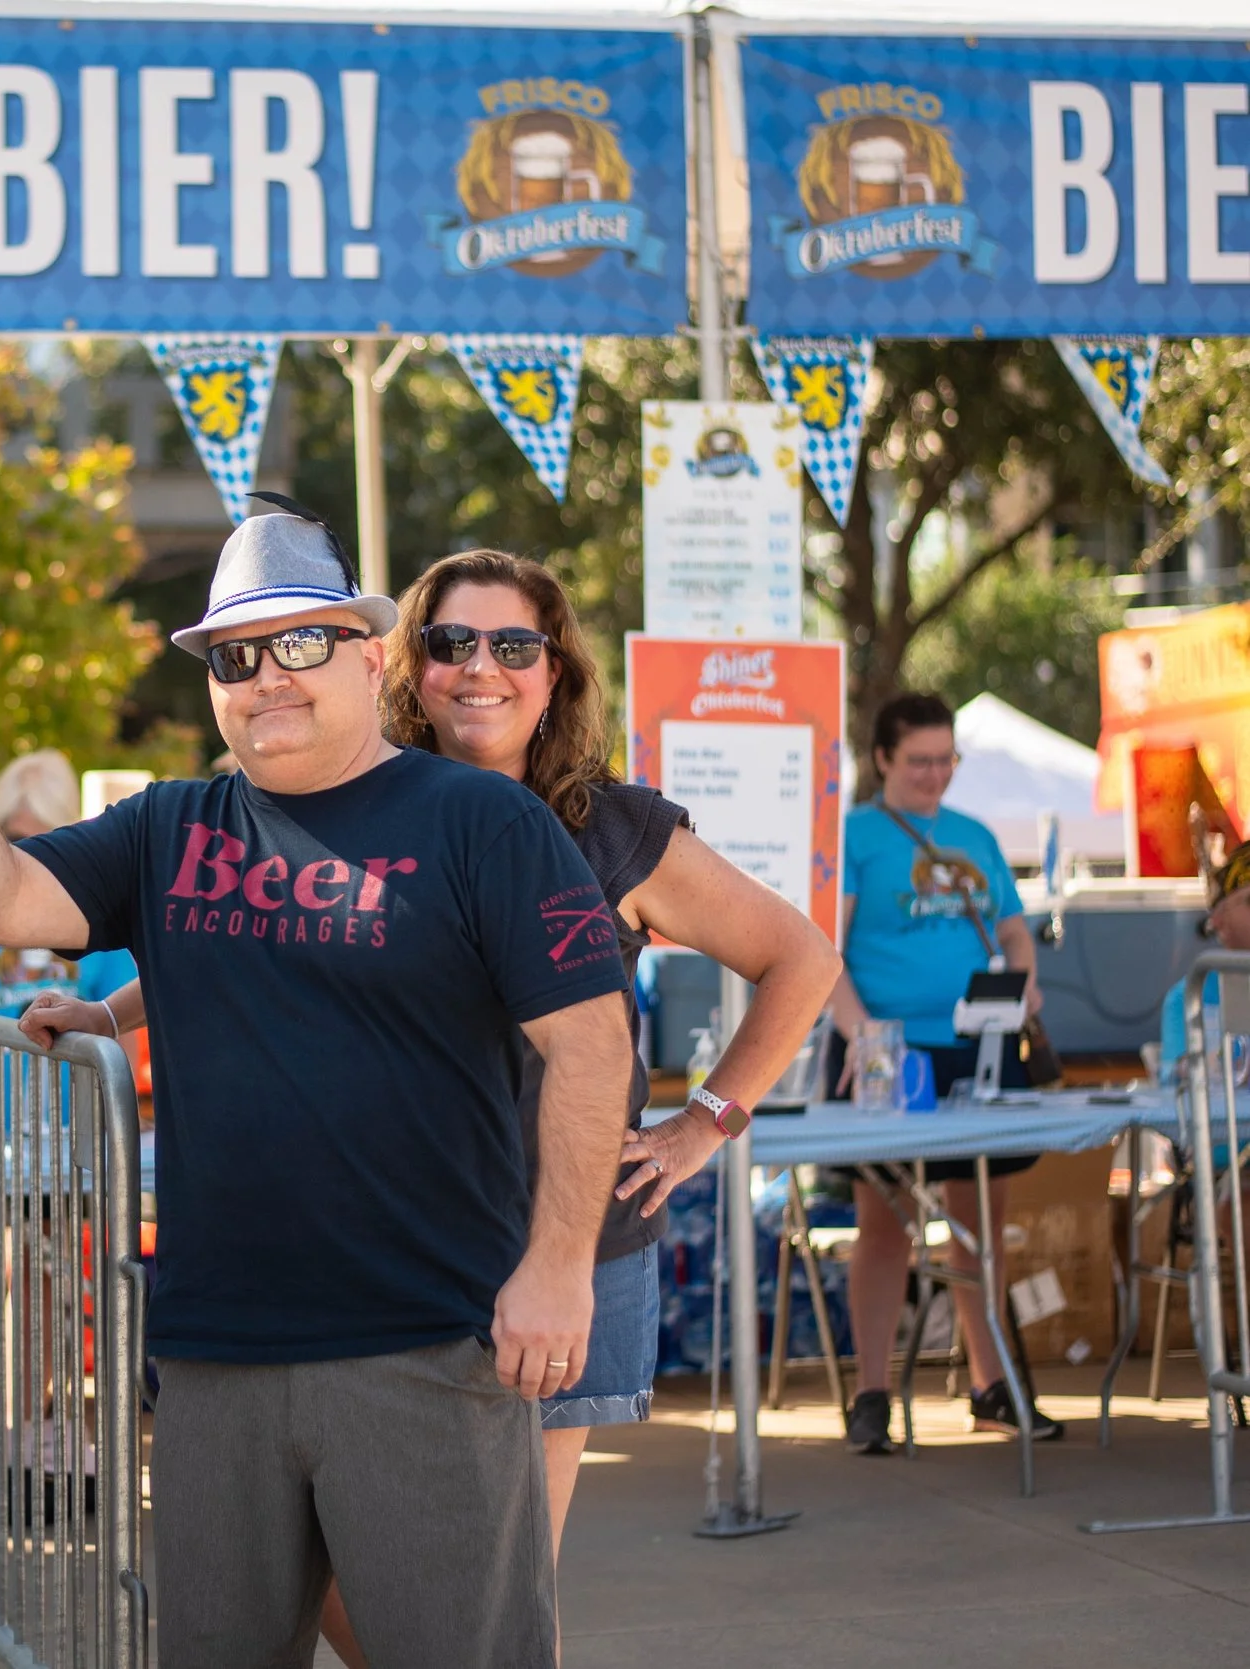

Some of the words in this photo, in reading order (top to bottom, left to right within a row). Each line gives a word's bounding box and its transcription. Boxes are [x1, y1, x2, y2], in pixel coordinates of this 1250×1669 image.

[478, 77, 610, 117] FRISCO
[816, 83, 944, 119] FRISCO
[456, 207, 631, 270] Oktoberfest
[798, 207, 963, 274] Oktoberfest
[699, 648, 776, 689] Shiner
[690, 690, 786, 719] Oktoberfest
[164, 821, 419, 913] Beer
[165, 903, 387, 949] ENCOURAGES
